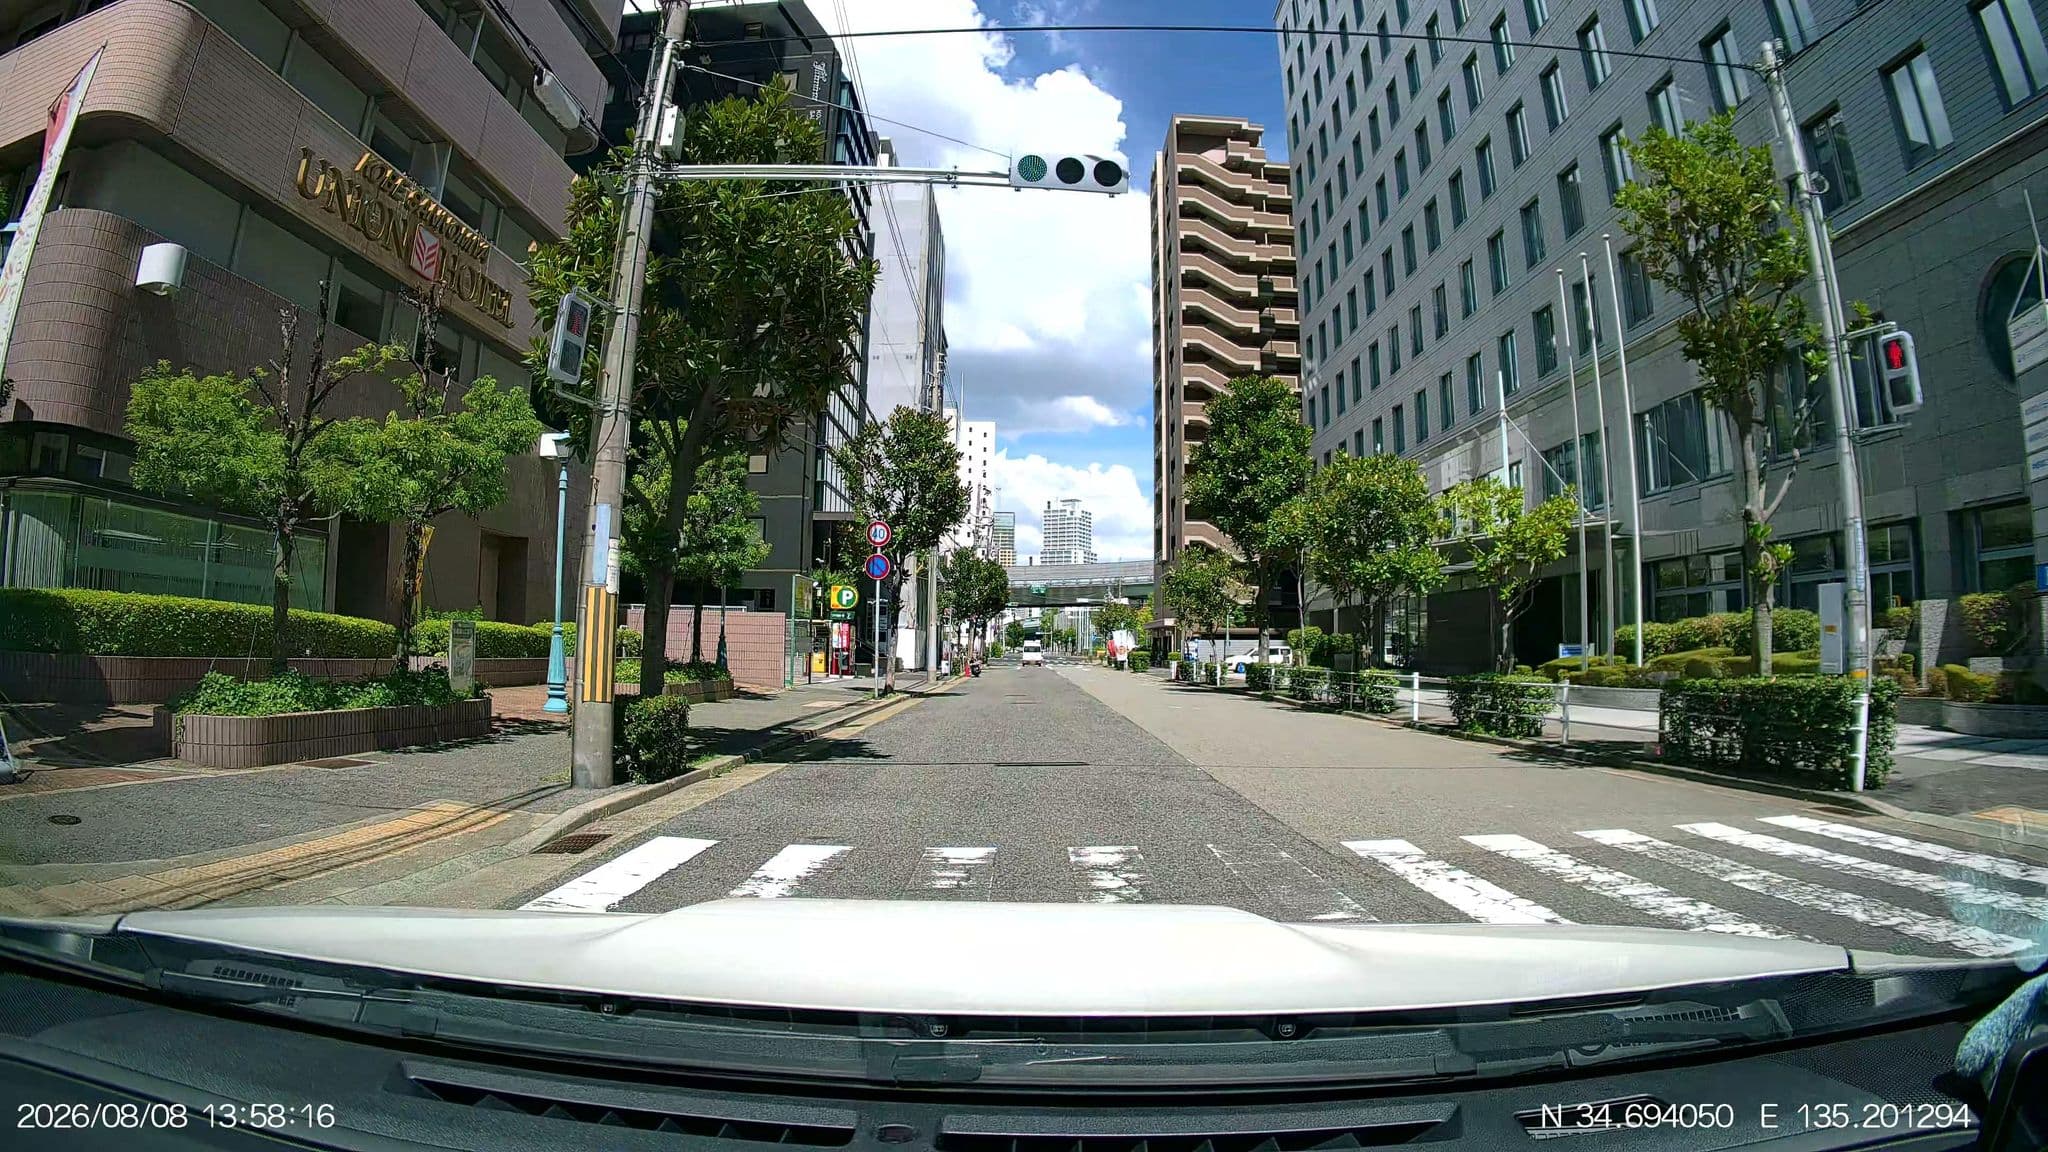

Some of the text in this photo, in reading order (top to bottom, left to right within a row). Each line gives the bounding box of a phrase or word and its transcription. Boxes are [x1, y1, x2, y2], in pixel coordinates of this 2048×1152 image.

[296, 145, 516, 328] UNION HOTEL
[872, 527, 885, 539] 40
[842, 590, 854, 605] P
